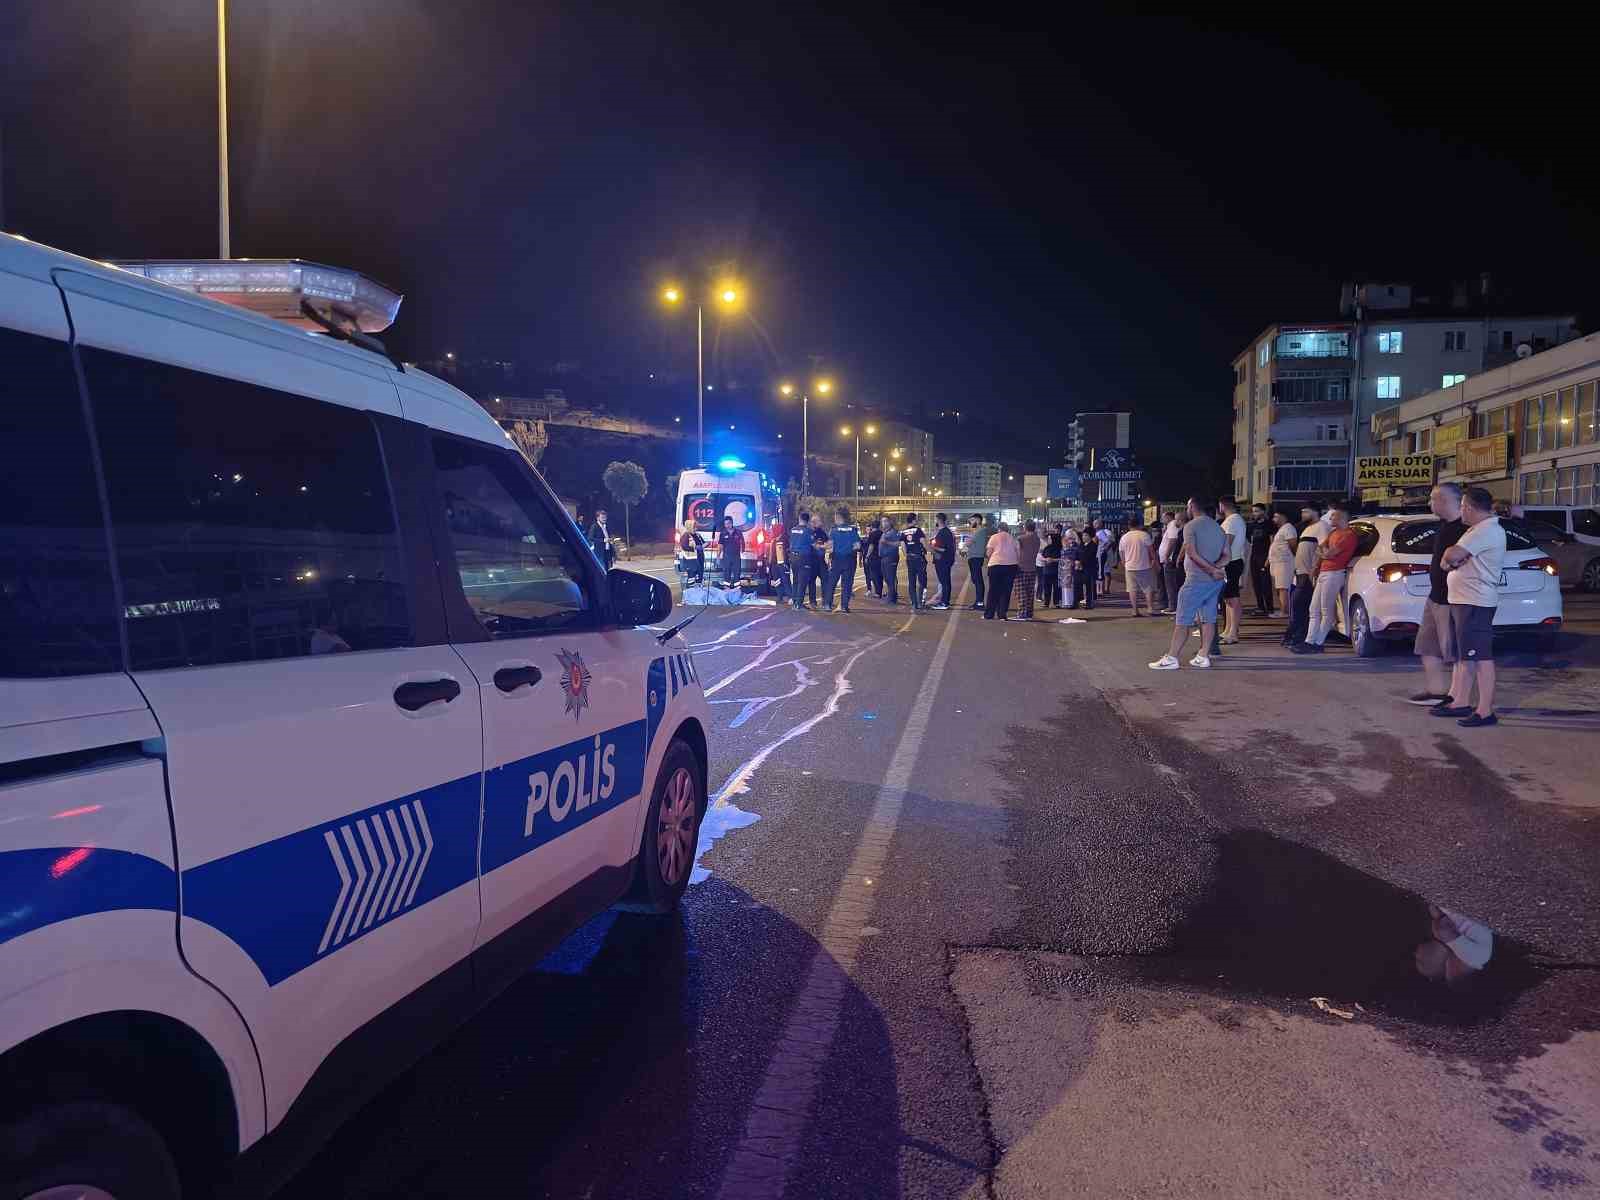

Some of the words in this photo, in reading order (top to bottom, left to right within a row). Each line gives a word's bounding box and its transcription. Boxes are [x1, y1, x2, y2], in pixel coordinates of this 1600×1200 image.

[1360, 457, 1400, 469] ÇINAR
[1404, 456, 1431, 466] OTO
[1112, 471, 1143, 479] AHMET
[1359, 468, 1430, 479] AKSESUAR
[695, 509, 714, 518] 112
[523, 733, 616, 838] POLİS
